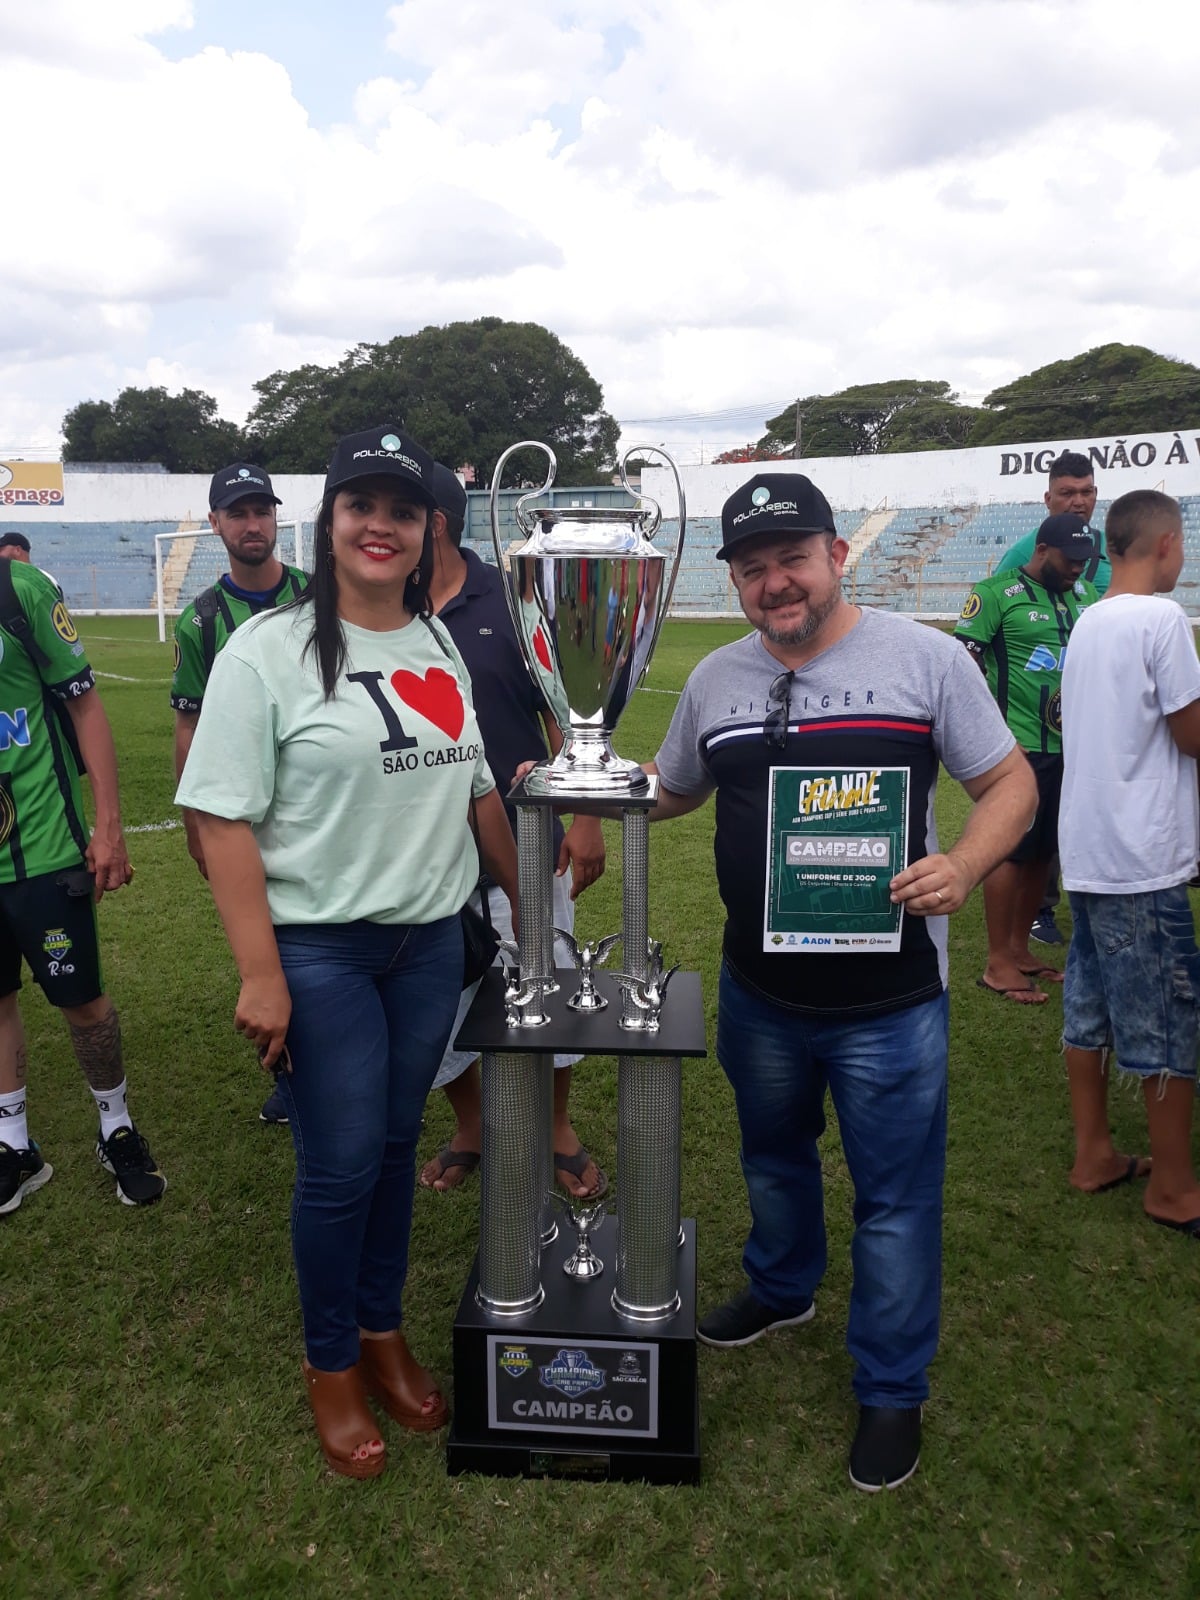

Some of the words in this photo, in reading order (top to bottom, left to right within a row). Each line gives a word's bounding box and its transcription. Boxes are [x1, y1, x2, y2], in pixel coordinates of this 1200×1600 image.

[352, 449, 422, 473] POLICARBON
[1000, 449, 1071, 476] DIG
[1087, 439, 1157, 469] NÃO
[1164, 432, 1190, 465] À
[732, 501, 798, 526] POLICARBON
[345, 670, 419, 753] I
[382, 751, 419, 775] SÃO
[423, 743, 479, 768] CARLOS
[798, 770, 881, 814] GRANDE
[789, 838, 887, 857] CAMPEÃO
[801, 873, 841, 881] UNIFORME
[854, 874, 877, 882] JOGO
[810, 937, 831, 945] ADN
[544, 1367, 601, 1382] CHAMPIONS
[512, 1399, 634, 1422] CAMPEÃO
